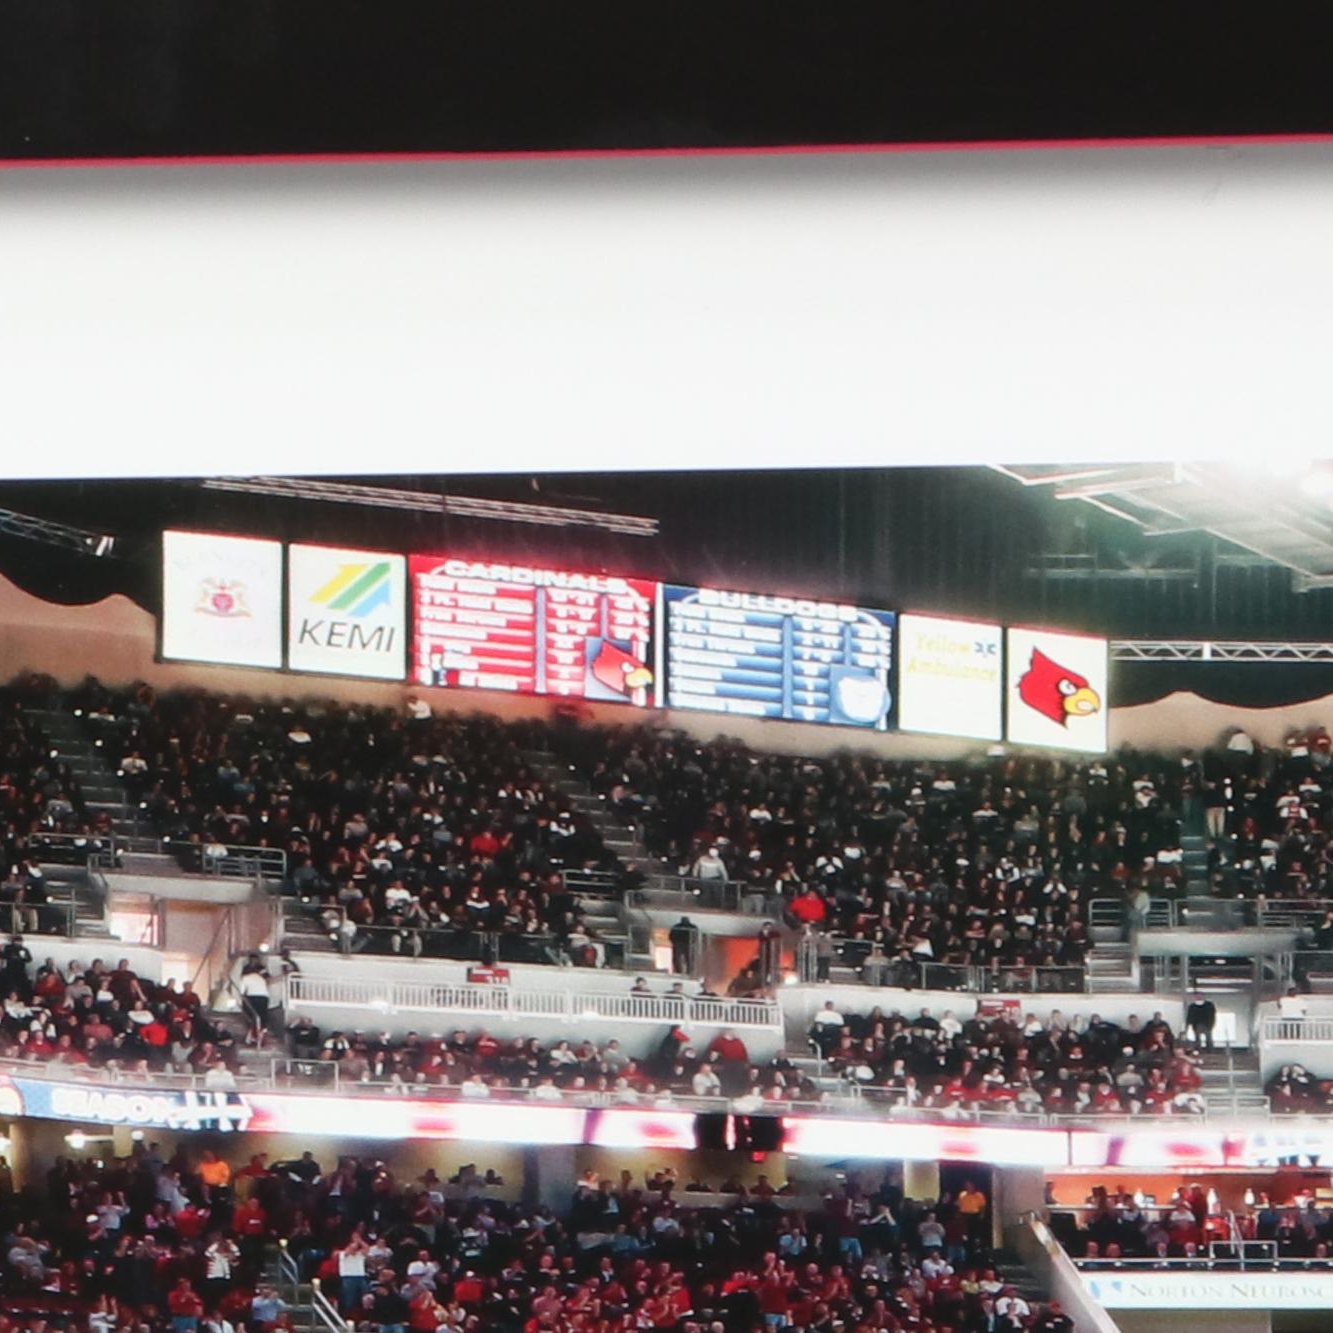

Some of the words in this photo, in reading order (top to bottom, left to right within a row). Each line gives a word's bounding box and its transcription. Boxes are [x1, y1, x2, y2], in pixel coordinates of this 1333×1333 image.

[444, 560, 629, 594] CARDINALS
[699, 588, 858, 622] BULLDOGS
[298, 618, 396, 653] KEMI
